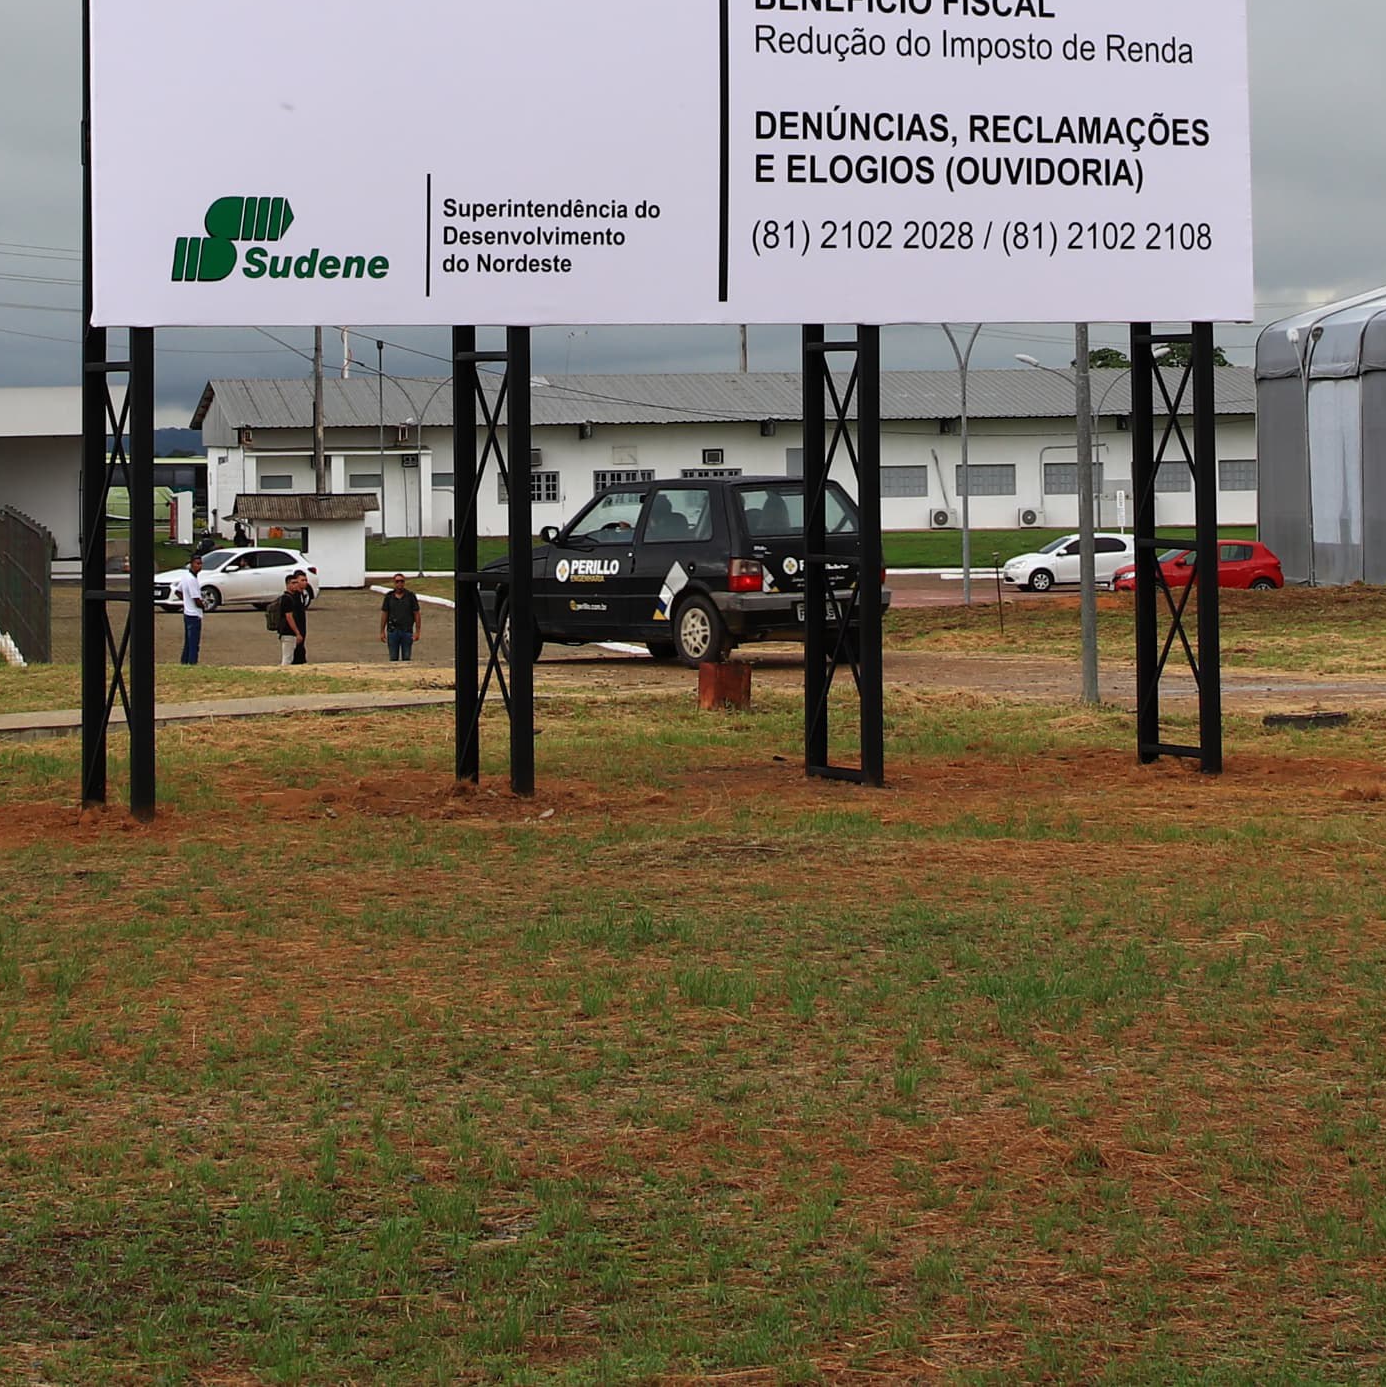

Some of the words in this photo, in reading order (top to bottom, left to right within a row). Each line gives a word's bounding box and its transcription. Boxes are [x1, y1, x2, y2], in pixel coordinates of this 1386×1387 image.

[756, 25, 885, 62] Redução
[897, 29, 930, 57] do
[943, 30, 1052, 65] Imposto
[1063, 34, 1095, 61] de
[1107, 35, 1192, 63] Renda
[756, 105, 957, 147] DENÚNCIAS,
[970, 113, 1209, 152] RECLAMAÇÕES
[756, 154, 774, 182] E
[788, 155, 934, 184] ELOGIOS
[946, 157, 1143, 193] (OUVIDORIA)
[444, 199, 627, 222] Superintendência
[635, 200, 660, 218] do
[444, 226, 625, 245] Desenvolvimento
[753, 220, 809, 256] (81)
[821, 221, 892, 249] 2102
[903, 221, 973, 249] 2028
[984, 222, 992, 249] /
[1003, 222, 1057, 256] (81)
[1068, 222, 1135, 249] 2102
[1146, 223, 1211, 250] 2108
[241, 246, 390, 279] Sudene
[443, 254, 469, 272] do
[477, 254, 571, 272] Nordeste
[571, 560, 619, 574] PERILLO
